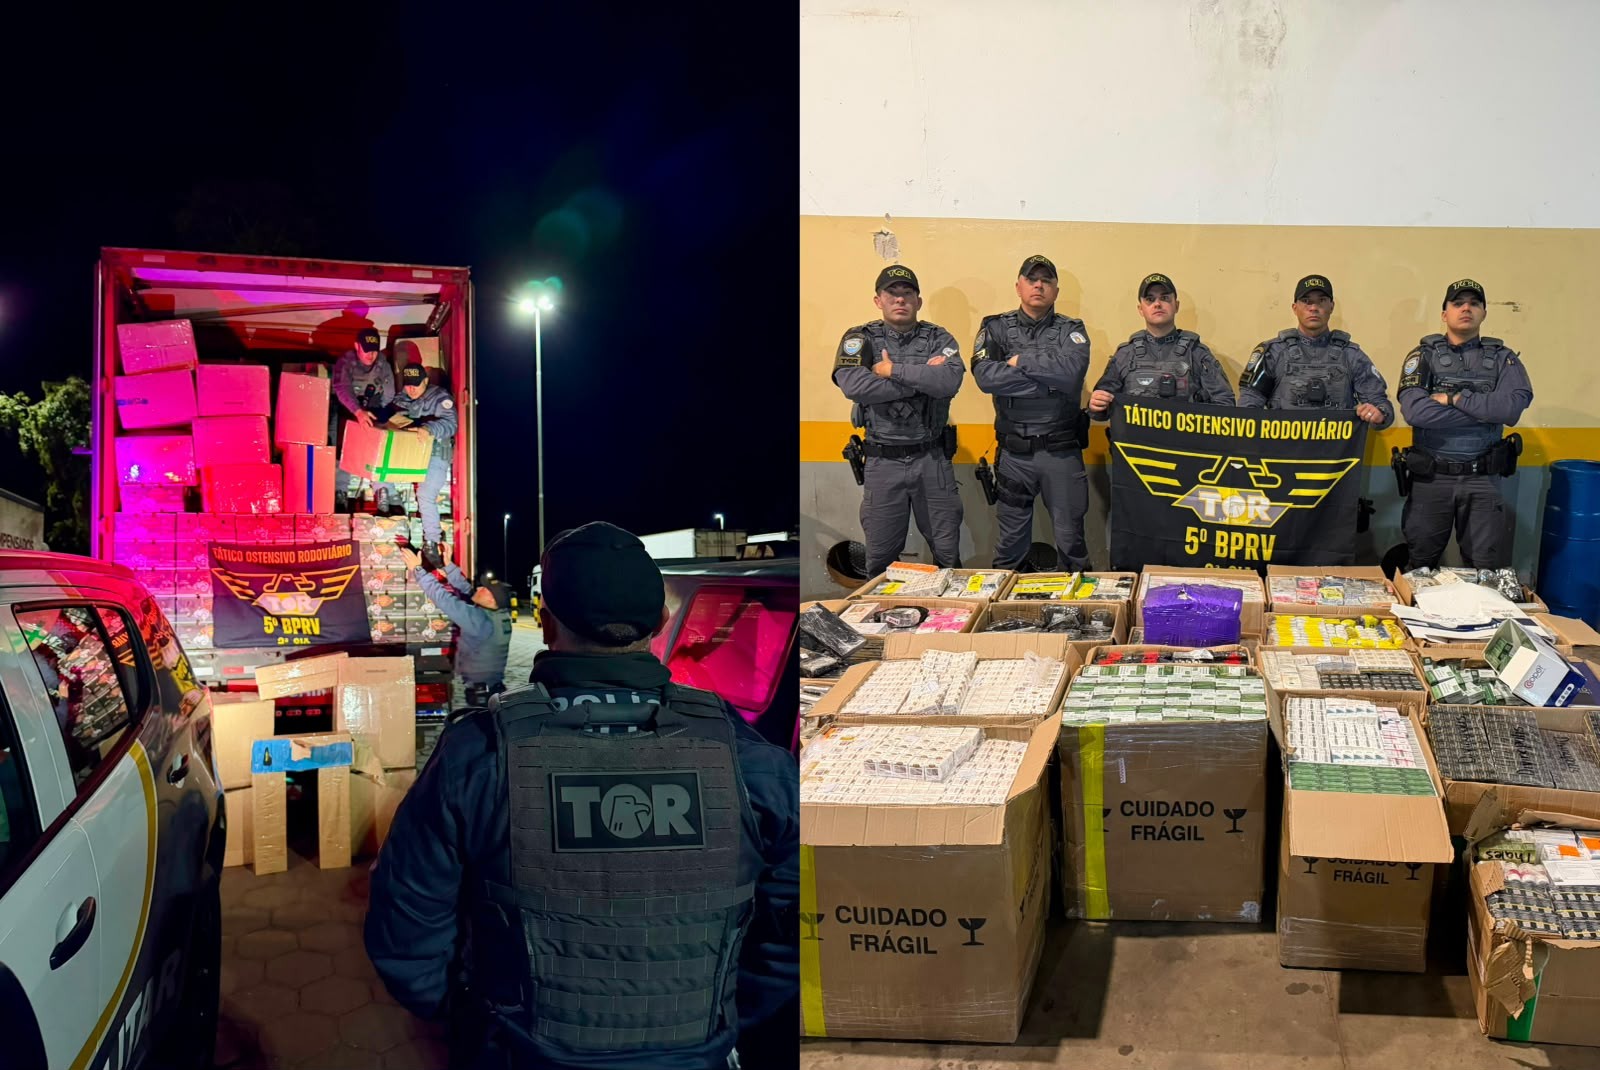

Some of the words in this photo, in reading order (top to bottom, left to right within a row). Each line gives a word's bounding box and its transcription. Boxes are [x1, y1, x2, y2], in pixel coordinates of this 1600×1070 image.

[1124, 403, 1172, 430] TÁTICO
[1176, 412, 1256, 438] OSTENSIVO
[1260, 418, 1353, 440] RODOVIÁRIO
[1198, 490, 1273, 522] TOR
[212, 546, 244, 562] TÁTICO
[245, 550, 296, 564] OSTENSIVO
[298, 544, 352, 563] RODOVIÁRIO
[1215, 530, 1277, 561] BPRV
[268, 596, 313, 613] TOR
[281, 617, 321, 636] BPRV
[560, 783, 697, 839] TOR
[1120, 800, 1215, 818] CUIDADO
[1131, 820, 1205, 841] FRÁGIL
[1333, 867, 1390, 885] FRÁGIL
[835, 905, 947, 928] CUIDADO
[849, 930, 938, 955] FRÁGIL
